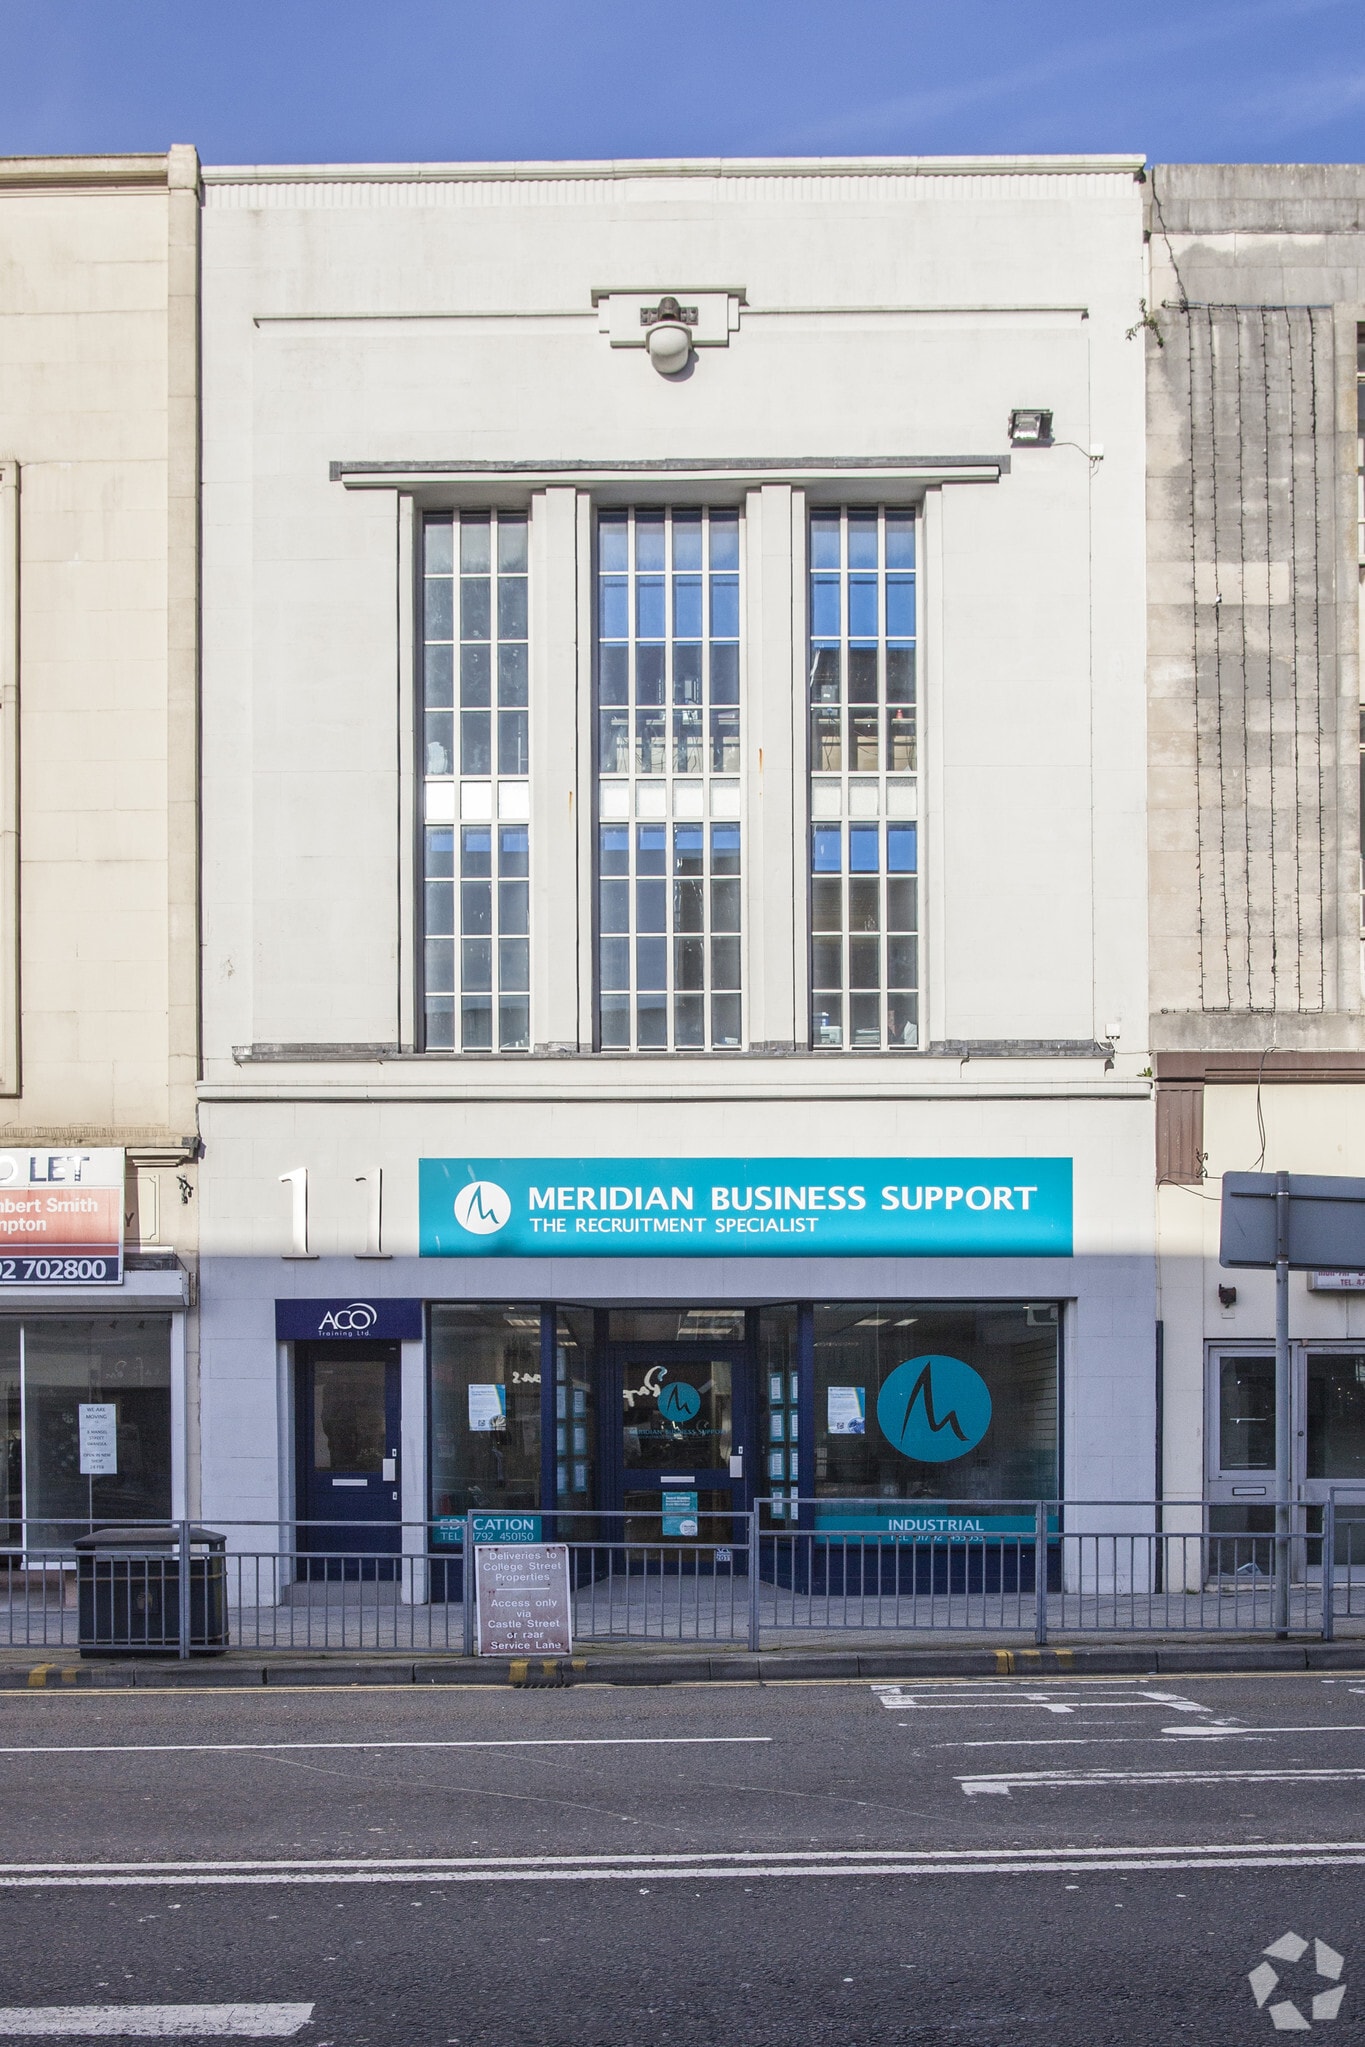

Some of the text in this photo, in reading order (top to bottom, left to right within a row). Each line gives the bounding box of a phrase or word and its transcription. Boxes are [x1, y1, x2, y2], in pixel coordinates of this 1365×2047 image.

[29, 1156, 90, 1182] LET
[529, 1186, 1038, 1210] MERIDIAN BUSINESS SUPPORT
[0, 1197, 98, 1212] bert Smith
[529, 1218, 819, 1233] THE RECRUITMENT SPECIALIST
[22, 1260, 107, 1279] 702800
[318, 1310, 371, 1329] ACO
[440, 1519, 534, 1531] EDCATION
[888, 1519, 984, 1531] INDUSTRIAL
[500, 1532, 534, 1541] 450150
[489, 1551, 557, 1560] Deliveries to
[483, 1562, 561, 1572] College Street
[495, 1573, 550, 1582] Properties
[491, 1599, 557, 1608] Access only
[488, 1620, 560, 1628] Castle Street
[490, 1641, 561, 1649] Service Lane
